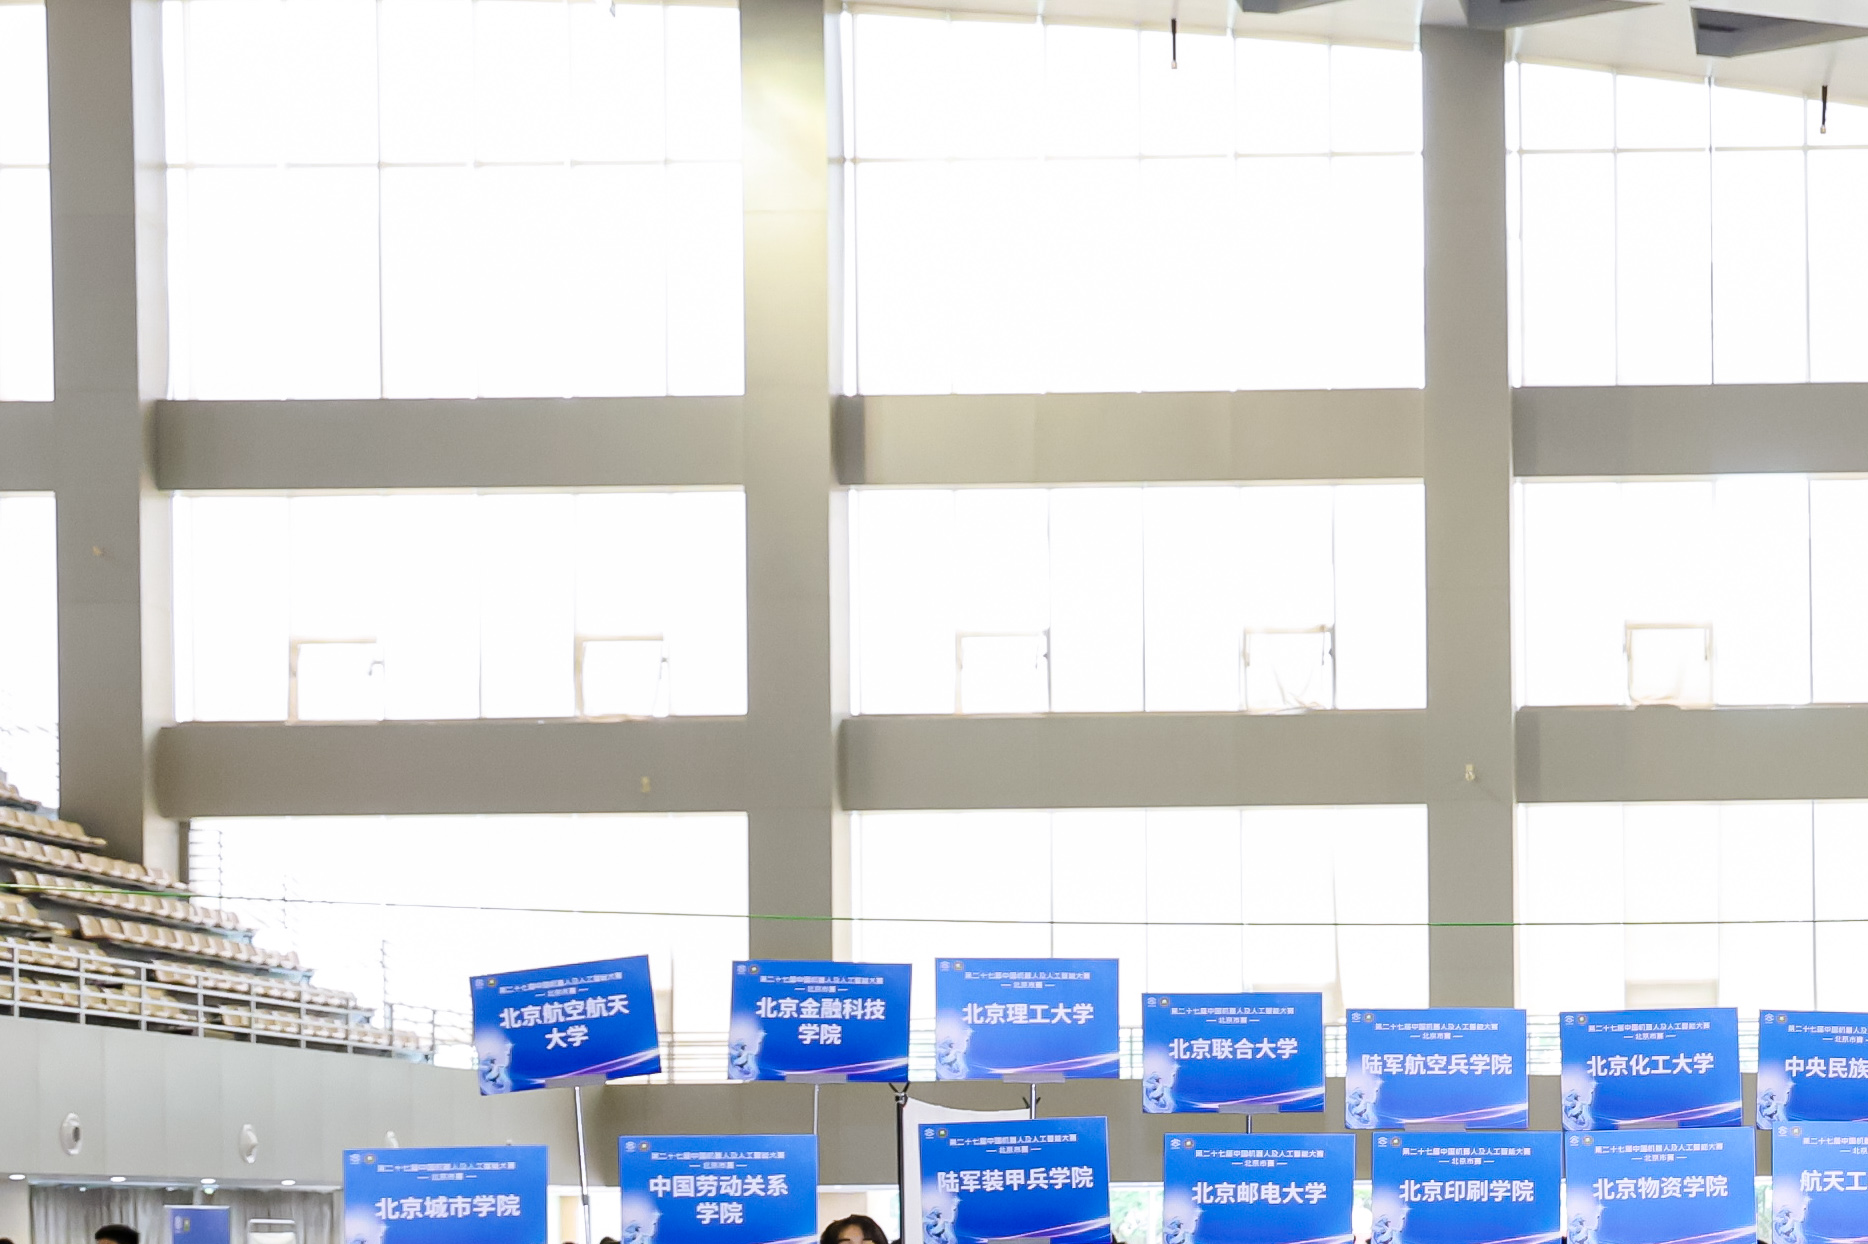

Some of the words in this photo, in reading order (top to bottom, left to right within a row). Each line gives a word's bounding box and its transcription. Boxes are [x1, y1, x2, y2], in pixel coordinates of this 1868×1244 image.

[499, 995, 629, 1029] 北京航空航天
[756, 997, 885, 1019] 北京金融科技
[959, 1003, 1093, 1027] 北京理工大学
[545, 1022, 588, 1049] 大学
[798, 1024, 841, 1044] 学院
[1167, 1038, 1297, 1061] 北京联合大学
[1359, 1054, 1512, 1078] 陆军航空兵学院
[1584, 1053, 1714, 1078] 北京化工大学
[650, 1174, 788, 1197] 中国劳动关系
[936, 1166, 1093, 1193] 陆军装甲兵学院
[1589, 1176, 1728, 1202] 北京物资学院
[1189, 1182, 1326, 1207] 北京邮电大学
[1397, 1180, 1534, 1205] 北京印刷学院
[372, 1194, 520, 1221] 北京城市学院
[697, 1202, 743, 1224] 学院
